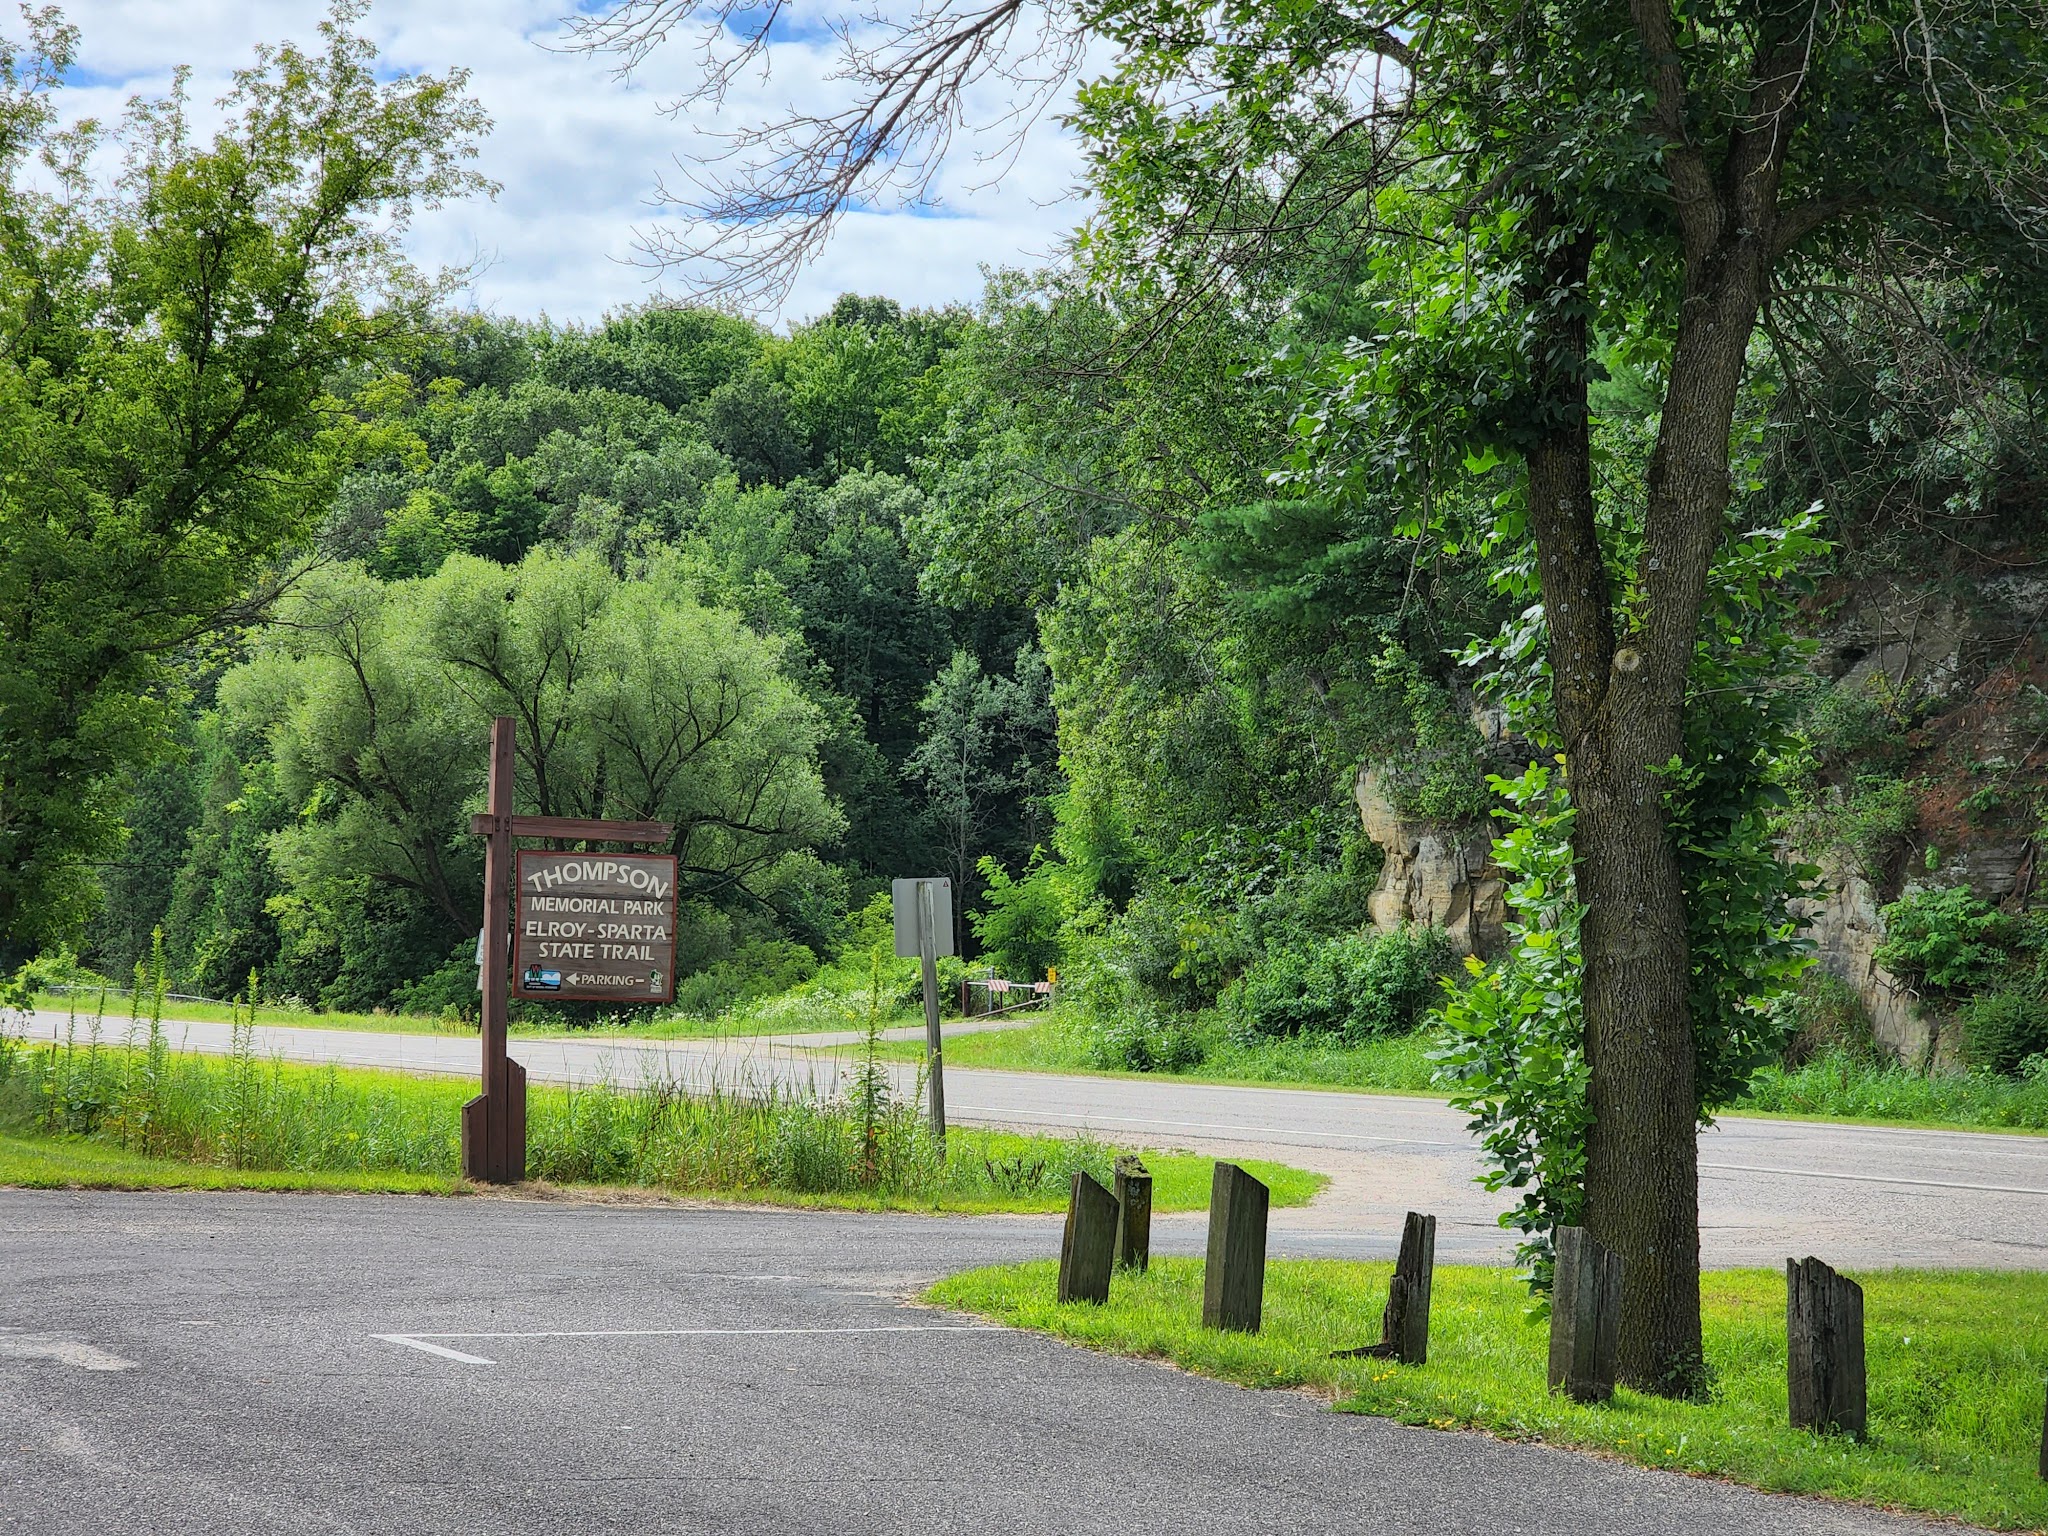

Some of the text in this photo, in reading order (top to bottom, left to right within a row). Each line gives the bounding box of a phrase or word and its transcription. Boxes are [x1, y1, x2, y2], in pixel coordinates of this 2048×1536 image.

[528, 862, 668, 899] THOMPSON
[531, 897, 664, 916] MEMORIAL PARK
[538, 942, 655, 961] STATE TRAIL
[581, 974, 634, 986] PARKING
